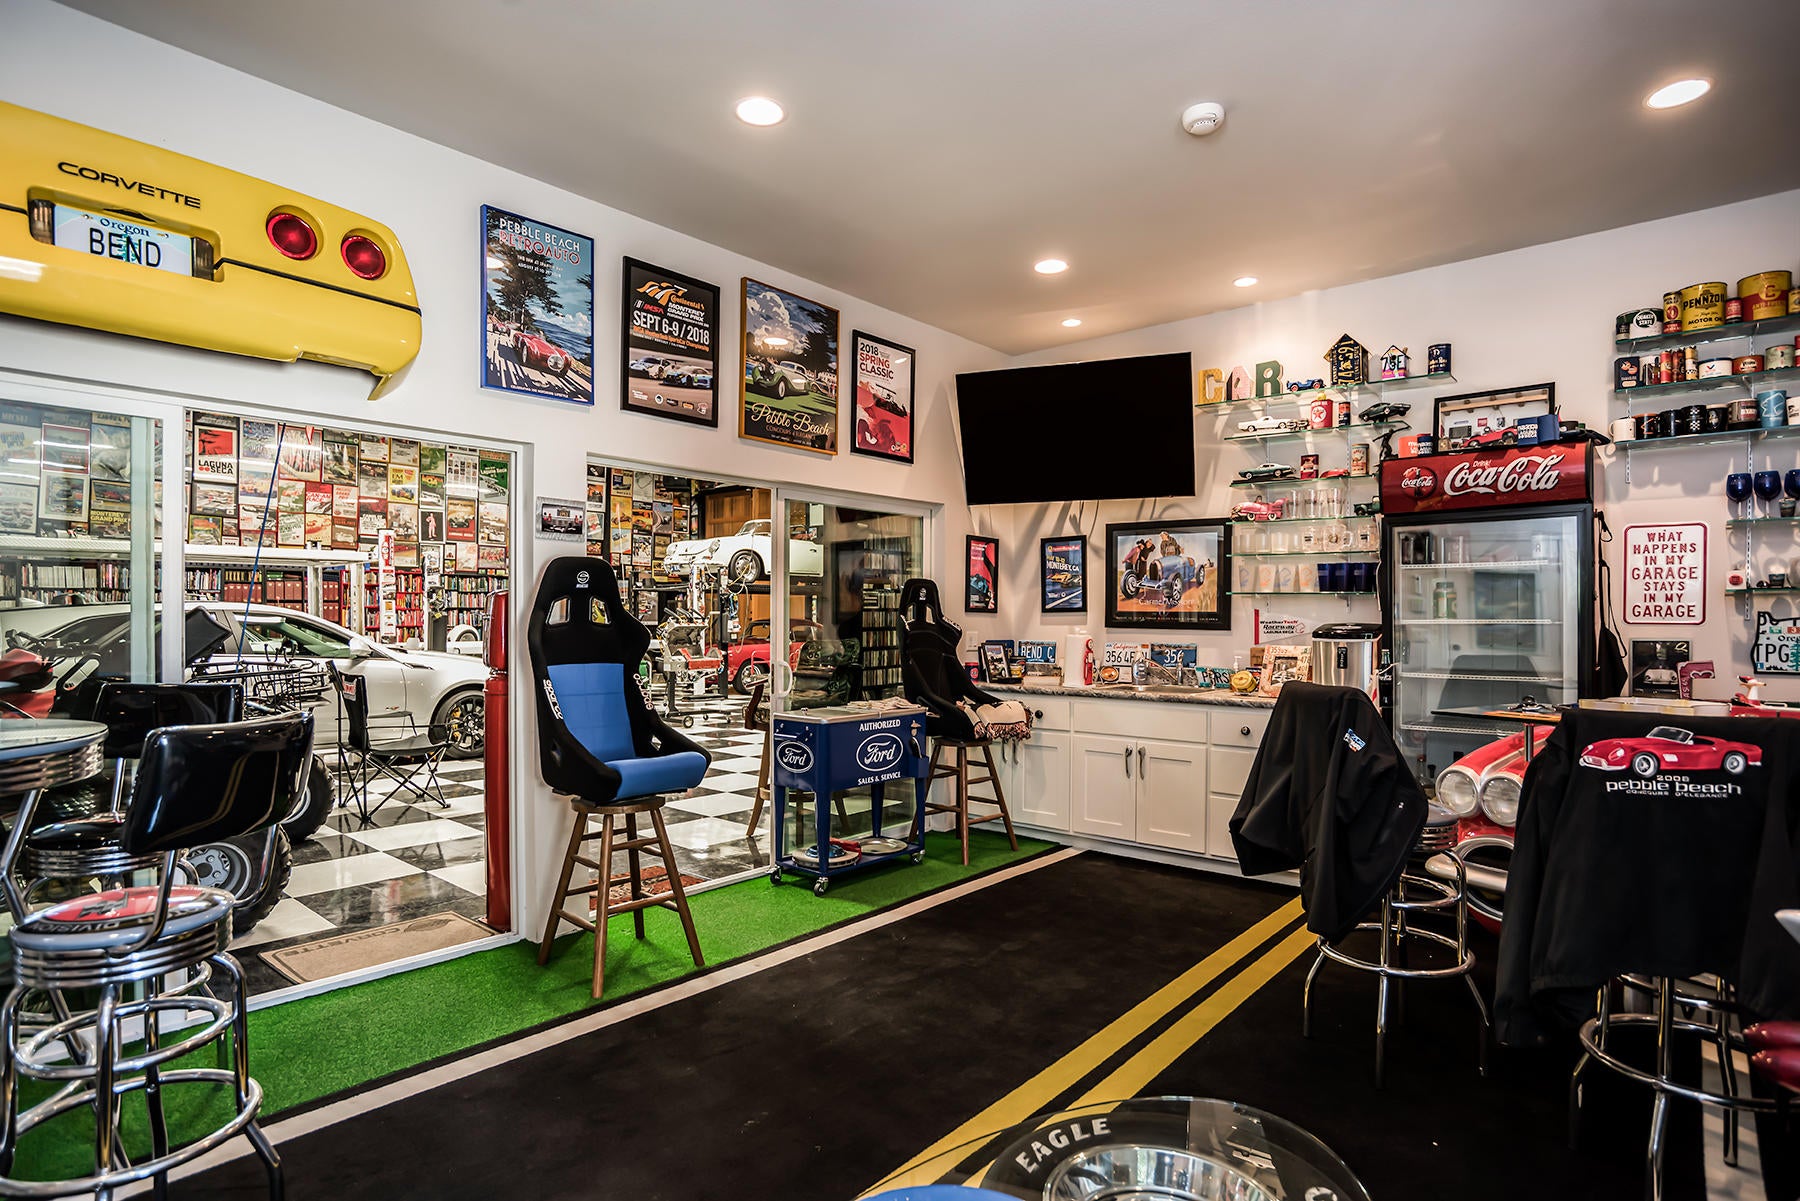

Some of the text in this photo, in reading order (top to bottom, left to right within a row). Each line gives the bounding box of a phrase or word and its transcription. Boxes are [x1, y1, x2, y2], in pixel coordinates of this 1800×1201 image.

[58, 161, 200, 209] CORVETTE
[100, 217, 150, 238] Oregon
[500, 217, 580, 252] PEBBLE BEACH
[89, 227, 162, 268] BEND
[499, 230, 580, 266] RETROAUTO
[643, 303, 664, 314] IMSA
[668, 302, 705, 317] MONTEREY
[670, 294, 701, 310] Continental
[1683, 294, 1724, 310] PENNZOIL
[667, 308, 689, 318] GRAND
[1688, 317, 1712, 325] MOTOR
[633, 310, 660, 331] SEPT
[662, 318, 679, 336] 6-9
[687, 326, 710, 345] 2018
[860, 343, 879, 355] 2018
[860, 352, 890, 368] SPRING
[860, 362, 894, 380] CLASSIC
[1198, 360, 1284, 404] CAR
[751, 403, 832, 435] Pebble Beach
[198, 460, 233, 469] LAGUNA
[1444, 454, 1566, 496] Coca-Cola
[1648, 532, 1683, 542] WHAT
[1633, 543, 1696, 554] HAPPENS
[1645, 555, 1684, 565] IN MY
[1632, 567, 1698, 580] GARAGE
[1644, 582, 1685, 591] STAYS
[1644, 593, 1683, 602] IN MY
[1632, 604, 1696, 617] GARAGE
[1106, 651, 1122, 663] 356
[1164, 650, 1182, 663] 356
[544, 679, 564, 720] sparco
[859, 719, 901, 732] AUTHORIZED
[783, 747, 807, 766] Ford
[865, 740, 895, 765] Ford
[858, 776, 874, 785] SALES
[881, 772, 901, 781] SERVICE
[1606, 779, 1741, 795] pebble beach
[284, 927, 401, 957] CORVETTE
[1015, 1117, 1112, 1174] EAGLE
